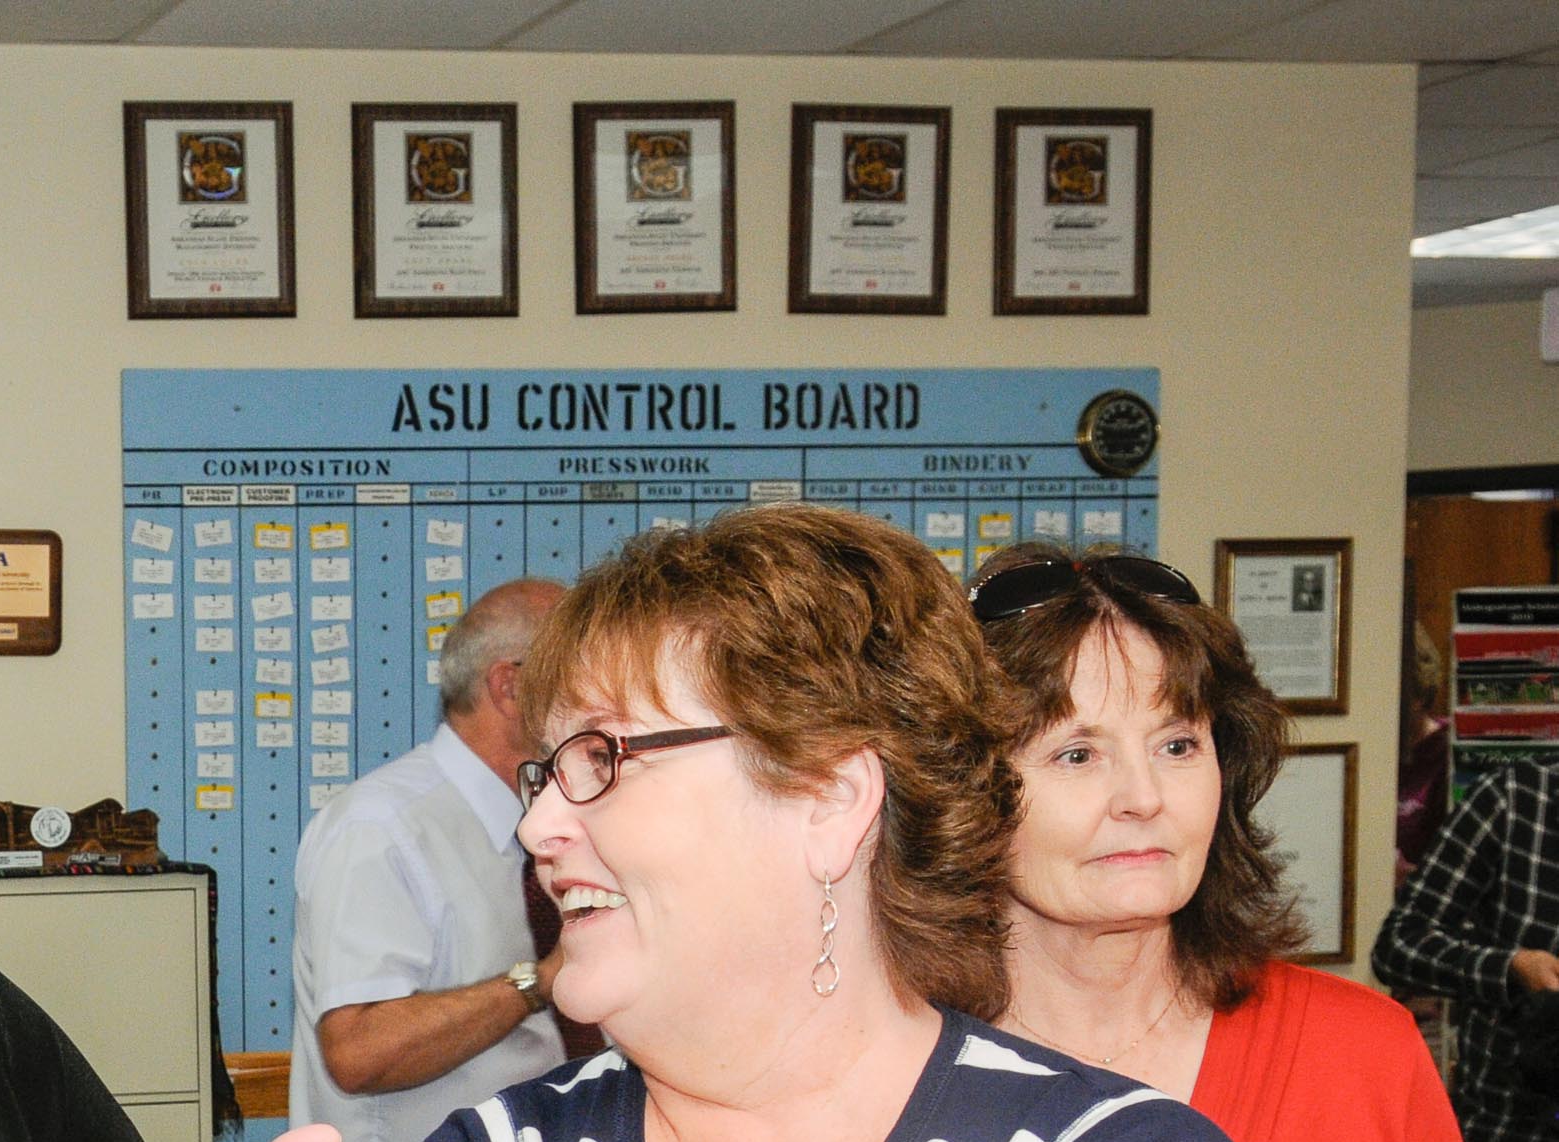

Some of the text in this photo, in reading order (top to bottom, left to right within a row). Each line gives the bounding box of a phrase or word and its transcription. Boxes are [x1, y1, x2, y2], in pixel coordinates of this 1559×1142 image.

[391, 381, 922, 432] ASU CONTROL BOARD
[203, 458, 392, 477] COMPOSITION
[558, 456, 711, 475] PRESSWORK
[923, 453, 1033, 472] BINDERY
[245, 487, 291, 495] CUSTOMER
[247, 494, 290, 502] PROOFING
[305, 489, 346, 500] PREP
